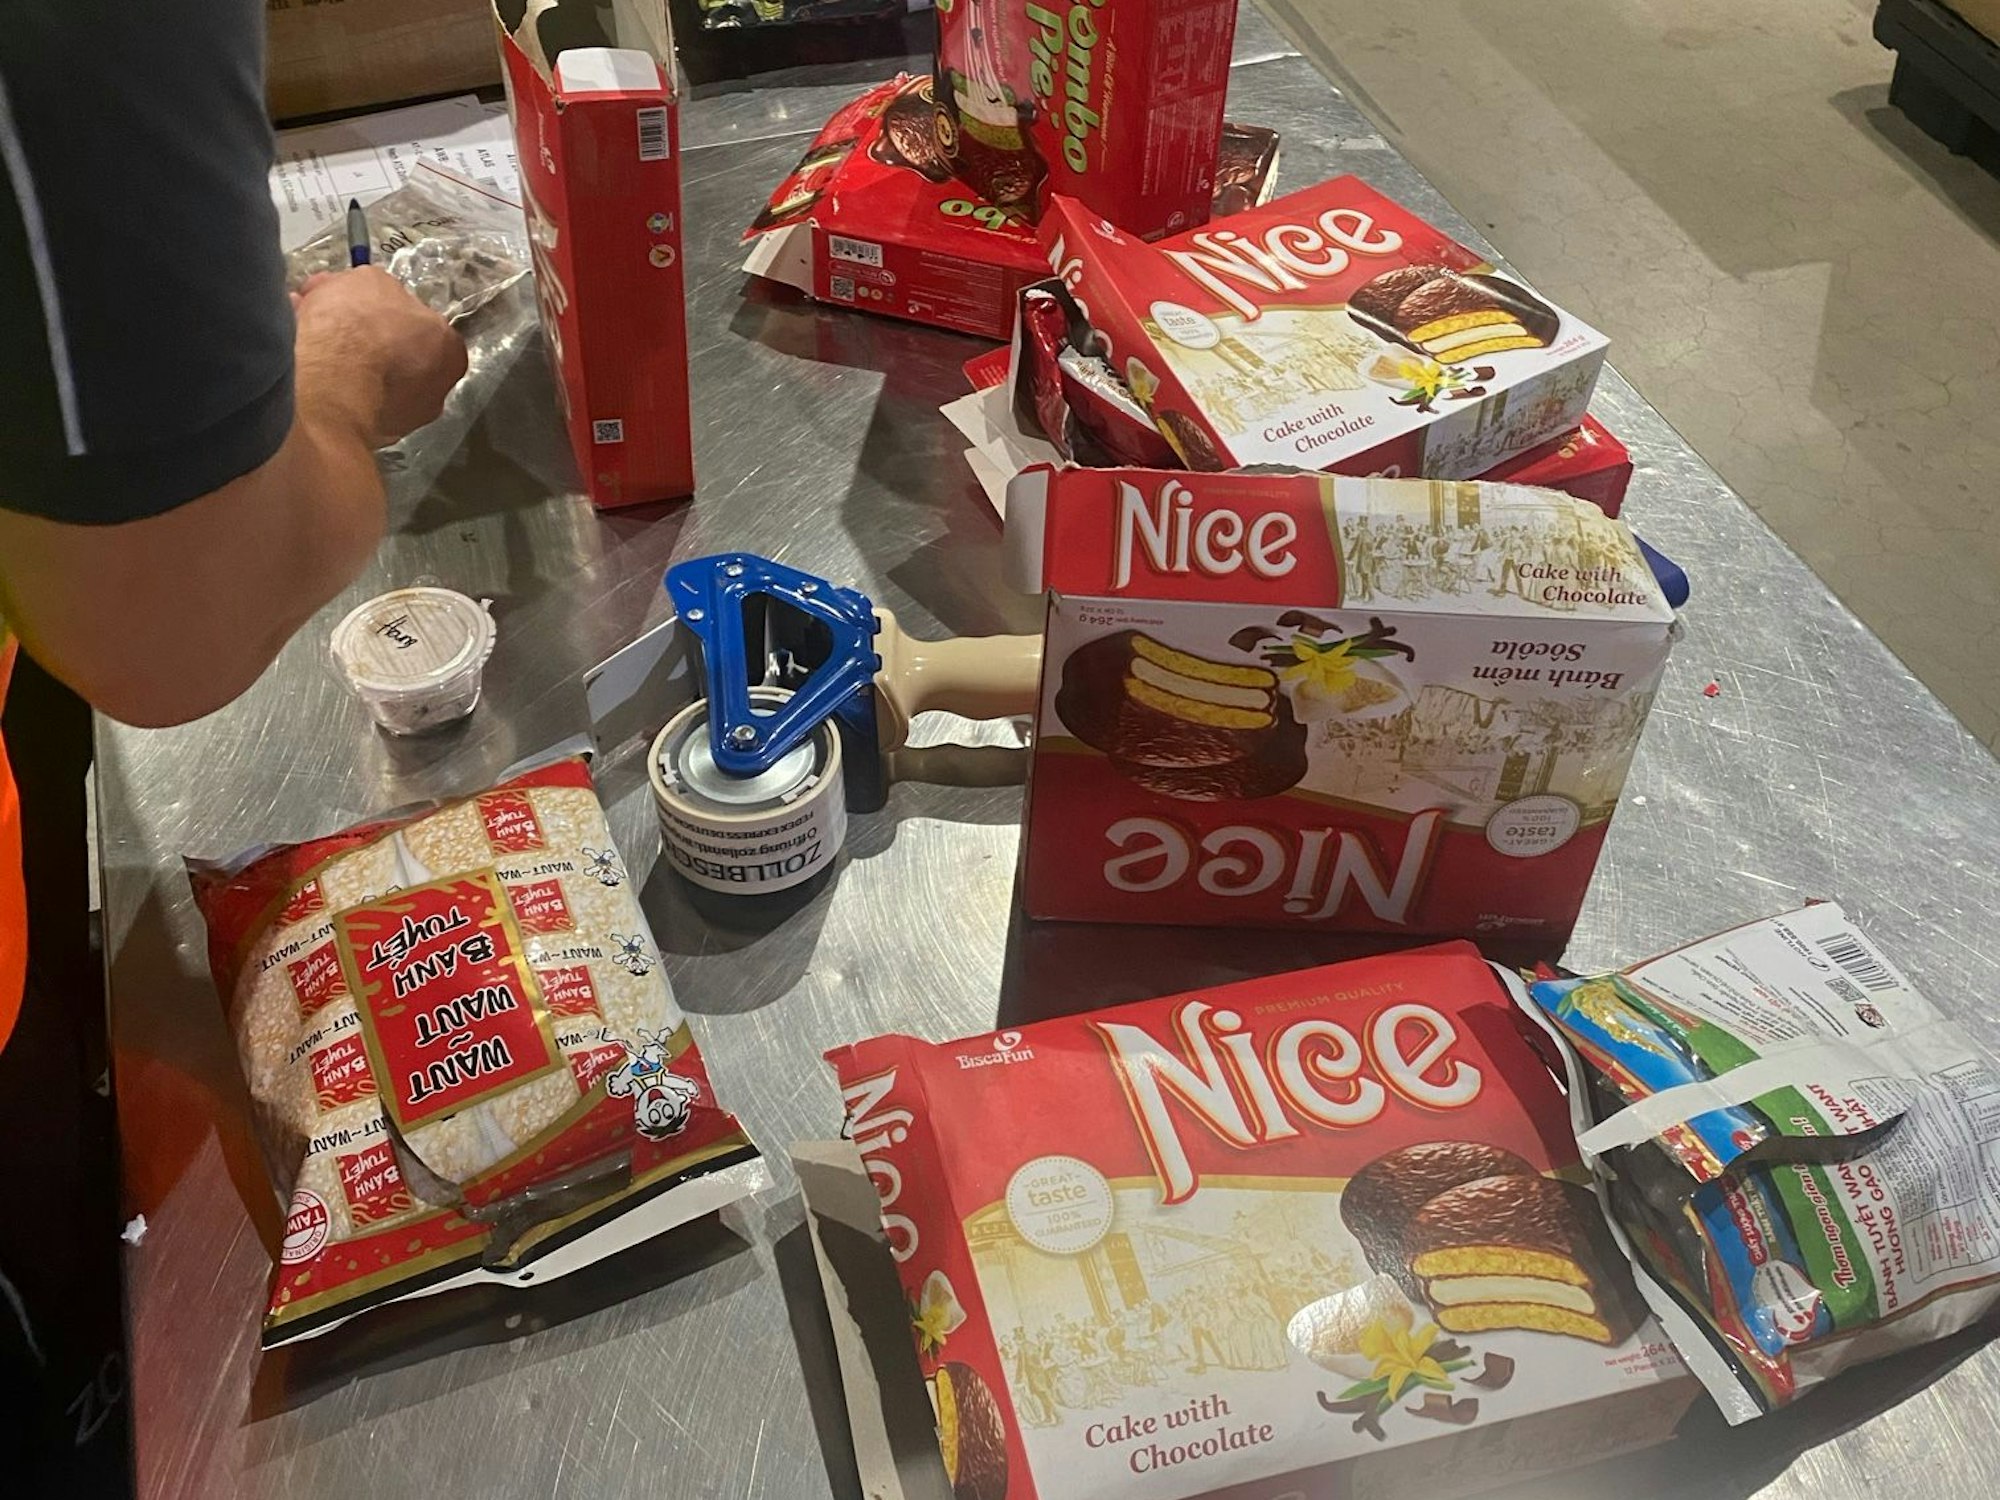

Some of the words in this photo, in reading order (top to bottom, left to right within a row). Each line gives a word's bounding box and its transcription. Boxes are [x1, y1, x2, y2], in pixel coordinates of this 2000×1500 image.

[1025, 2, 1064, 97] Pie
[1063, 0, 1104, 174] ombo
[1161, 208, 1403, 323] Nice
[1264, 421, 1306, 443] Cake
[1306, 403, 1345, 426] with
[1295, 414, 1375, 453] Chocolate
[1110, 479, 1297, 590] Nice
[1518, 563, 1569, 580] Cake
[1576, 567, 1622, 583] with
[1543, 585, 1648, 606] Chocolate
[1491, 641, 1586, 662] Sôcôla
[1472, 666, 1541, 687] mềm
[1549, 668, 1624, 690] Bánh
[496, 820, 536, 838] BÁNH
[726, 825, 780, 840] EXPRESS
[779, 811, 814, 833] FEDEX
[1505, 826, 1557, 838] taste
[759, 827, 817, 858] Öffnung
[1103, 810, 1442, 926] Nice
[524, 899, 564, 917] BÁNH
[366, 906, 471, 973] TUYẾT
[393, 930, 495, 998] BÁNH
[552, 985, 592, 1002] BÁNH
[1254, 993, 1331, 1016] PREMIUM
[1335, 981, 1406, 1003] QUALITY
[415, 984, 518, 1047] WANT
[323, 1055, 367, 1086] BÁNH
[407, 1036, 514, 1104] WANT
[1090, 999, 1481, 1205] Nice
[1806, 1083, 1849, 1122] WANT
[355, 1165, 400, 1198] BÁNH
[1028, 1183, 1088, 1208] taste
[1030, 1172, 1076, 1189] GREAT
[1857, 1164, 1886, 1203] GẠO
[1047, 1210, 1082, 1224] 100%
[1816, 1207, 1842, 1250] ngon
[1854, 1203, 1886, 1256] TUYẾT
[1879, 1207, 1906, 1276] HƯƠNG
[1880, 1258, 1899, 1310] BÁNH
[1641, 1343, 1666, 1358] 264
[1085, 1414, 1158, 1449] Cake
[1163, 1393, 1231, 1429] with
[1129, 1423, 1275, 1474] Chocolate
